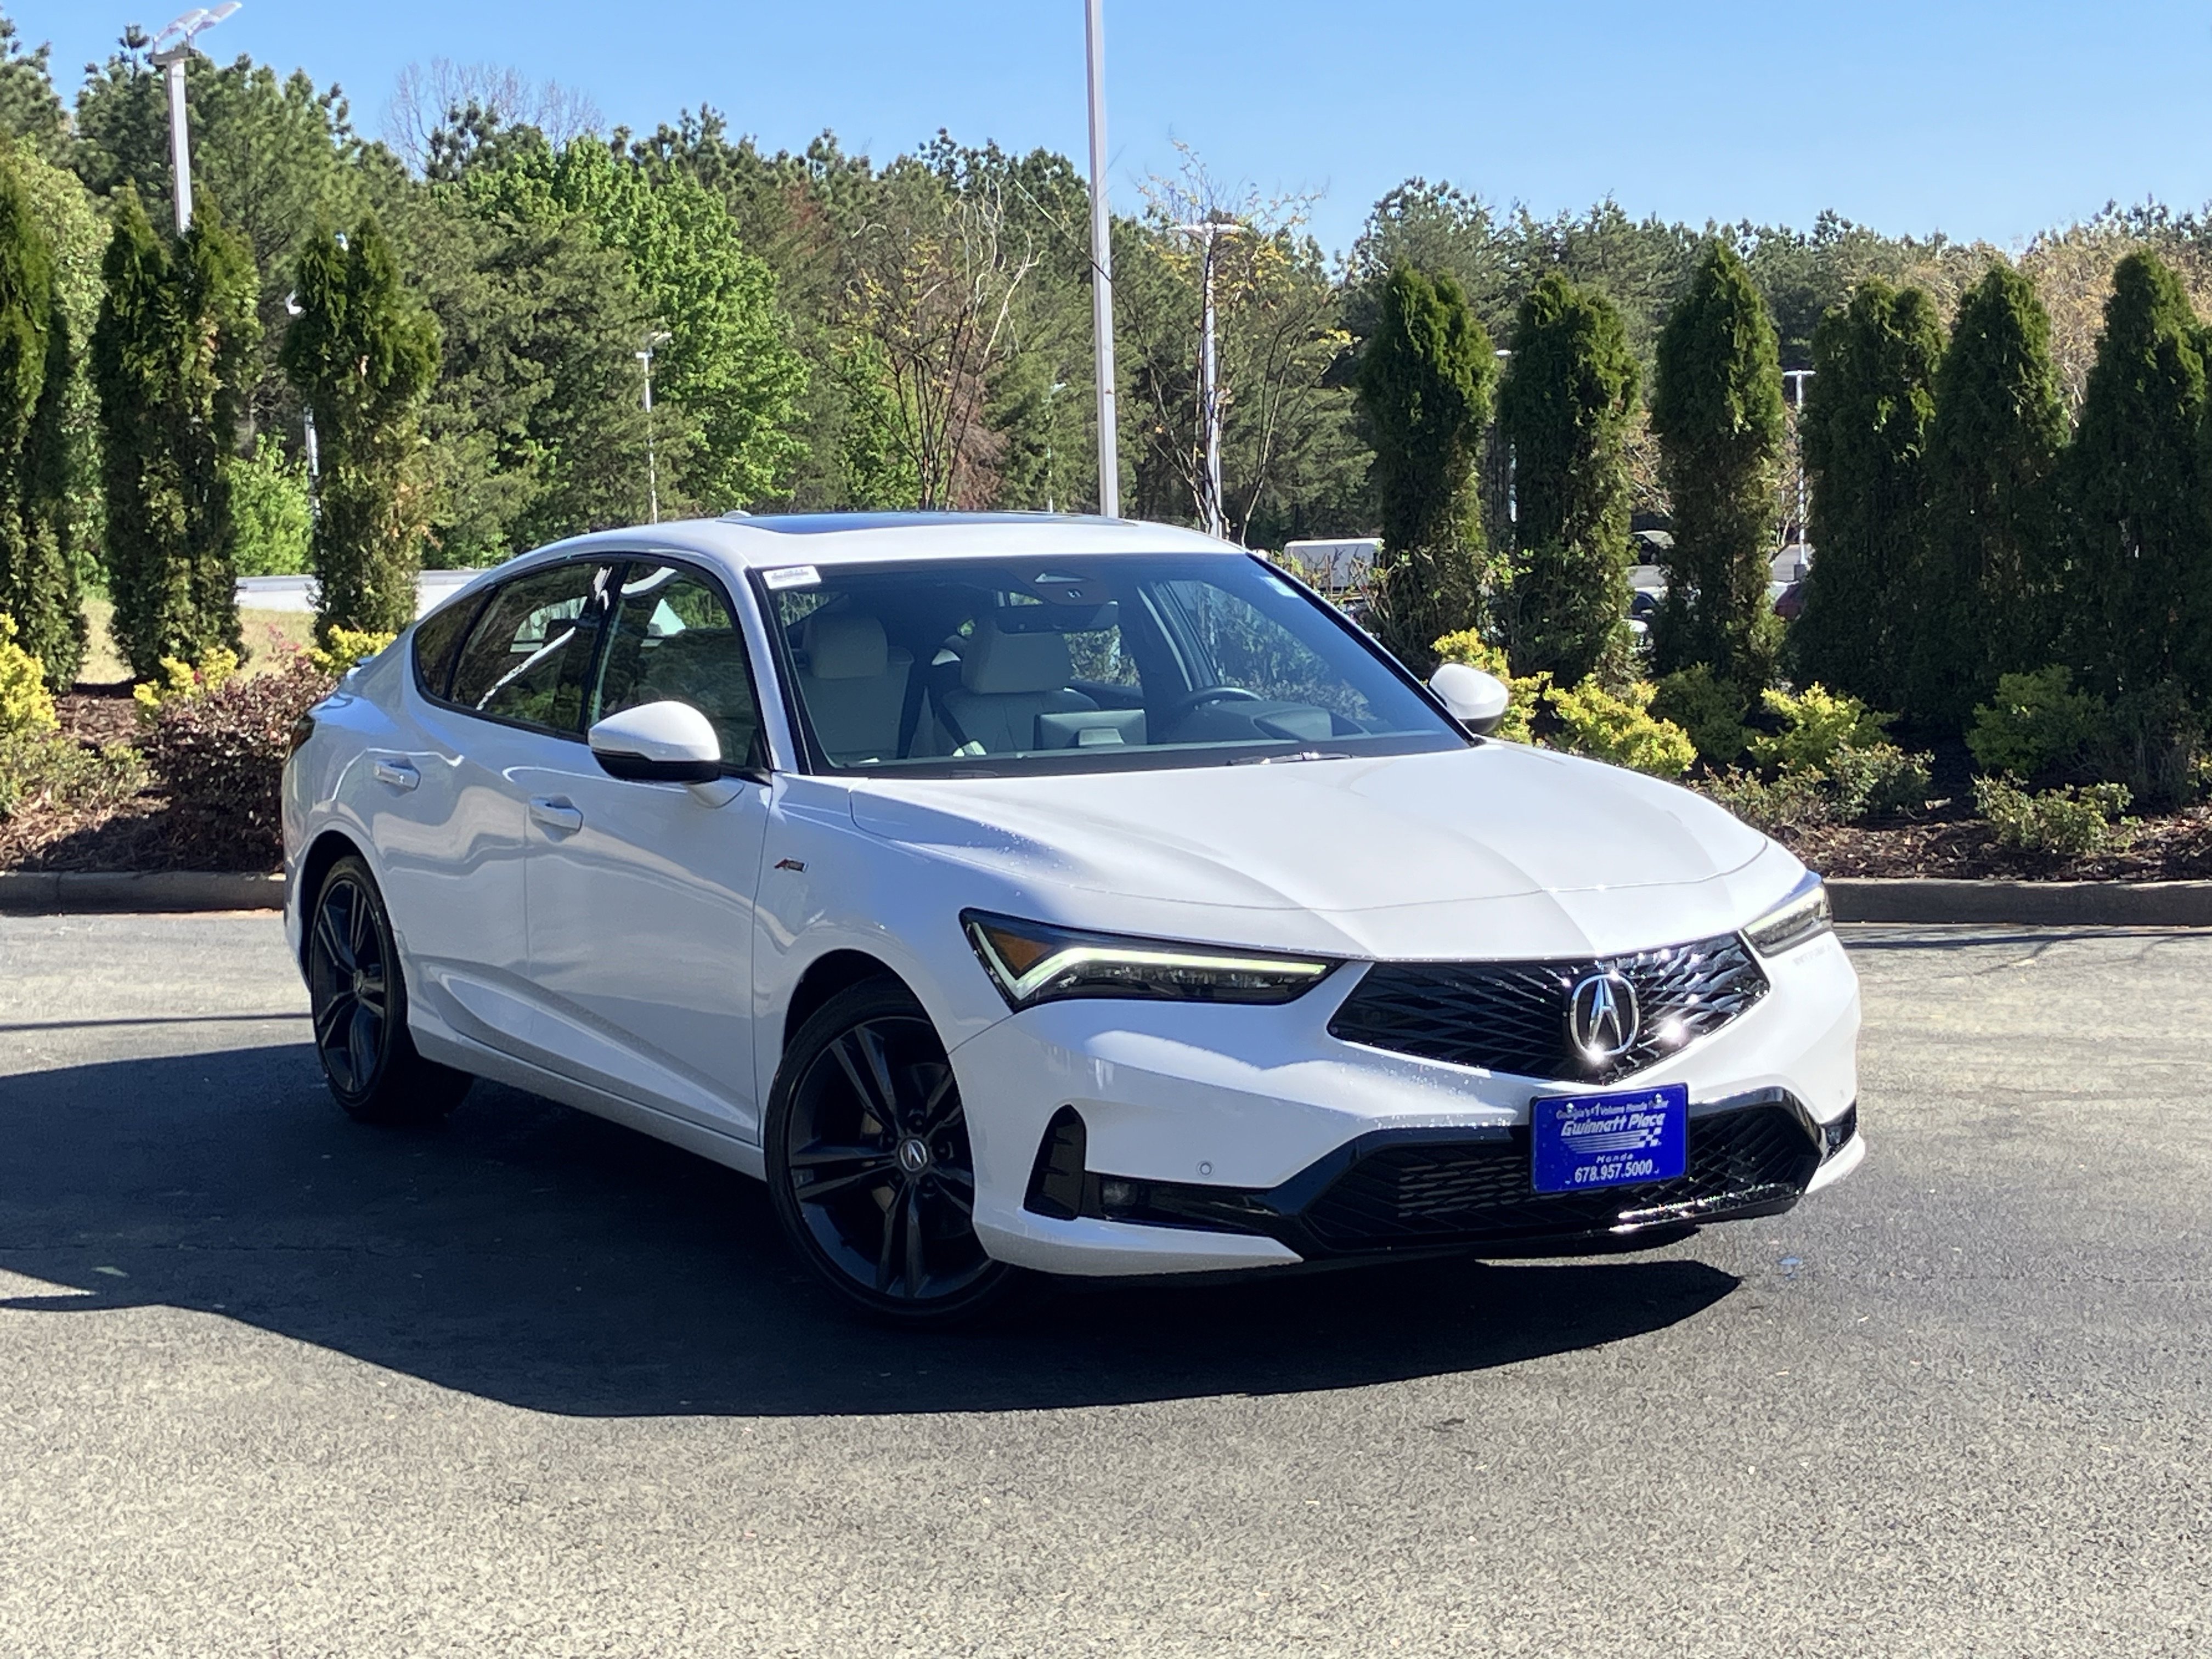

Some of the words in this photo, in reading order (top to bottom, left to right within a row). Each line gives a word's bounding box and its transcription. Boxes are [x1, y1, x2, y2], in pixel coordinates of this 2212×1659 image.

[1560, 1114, 1627, 1137] Gwinnett
[1627, 1112, 1666, 1130] Place
[1596, 1153, 1634, 1164] Honda
[1575, 1159, 1653, 1183] 678.957.5000
